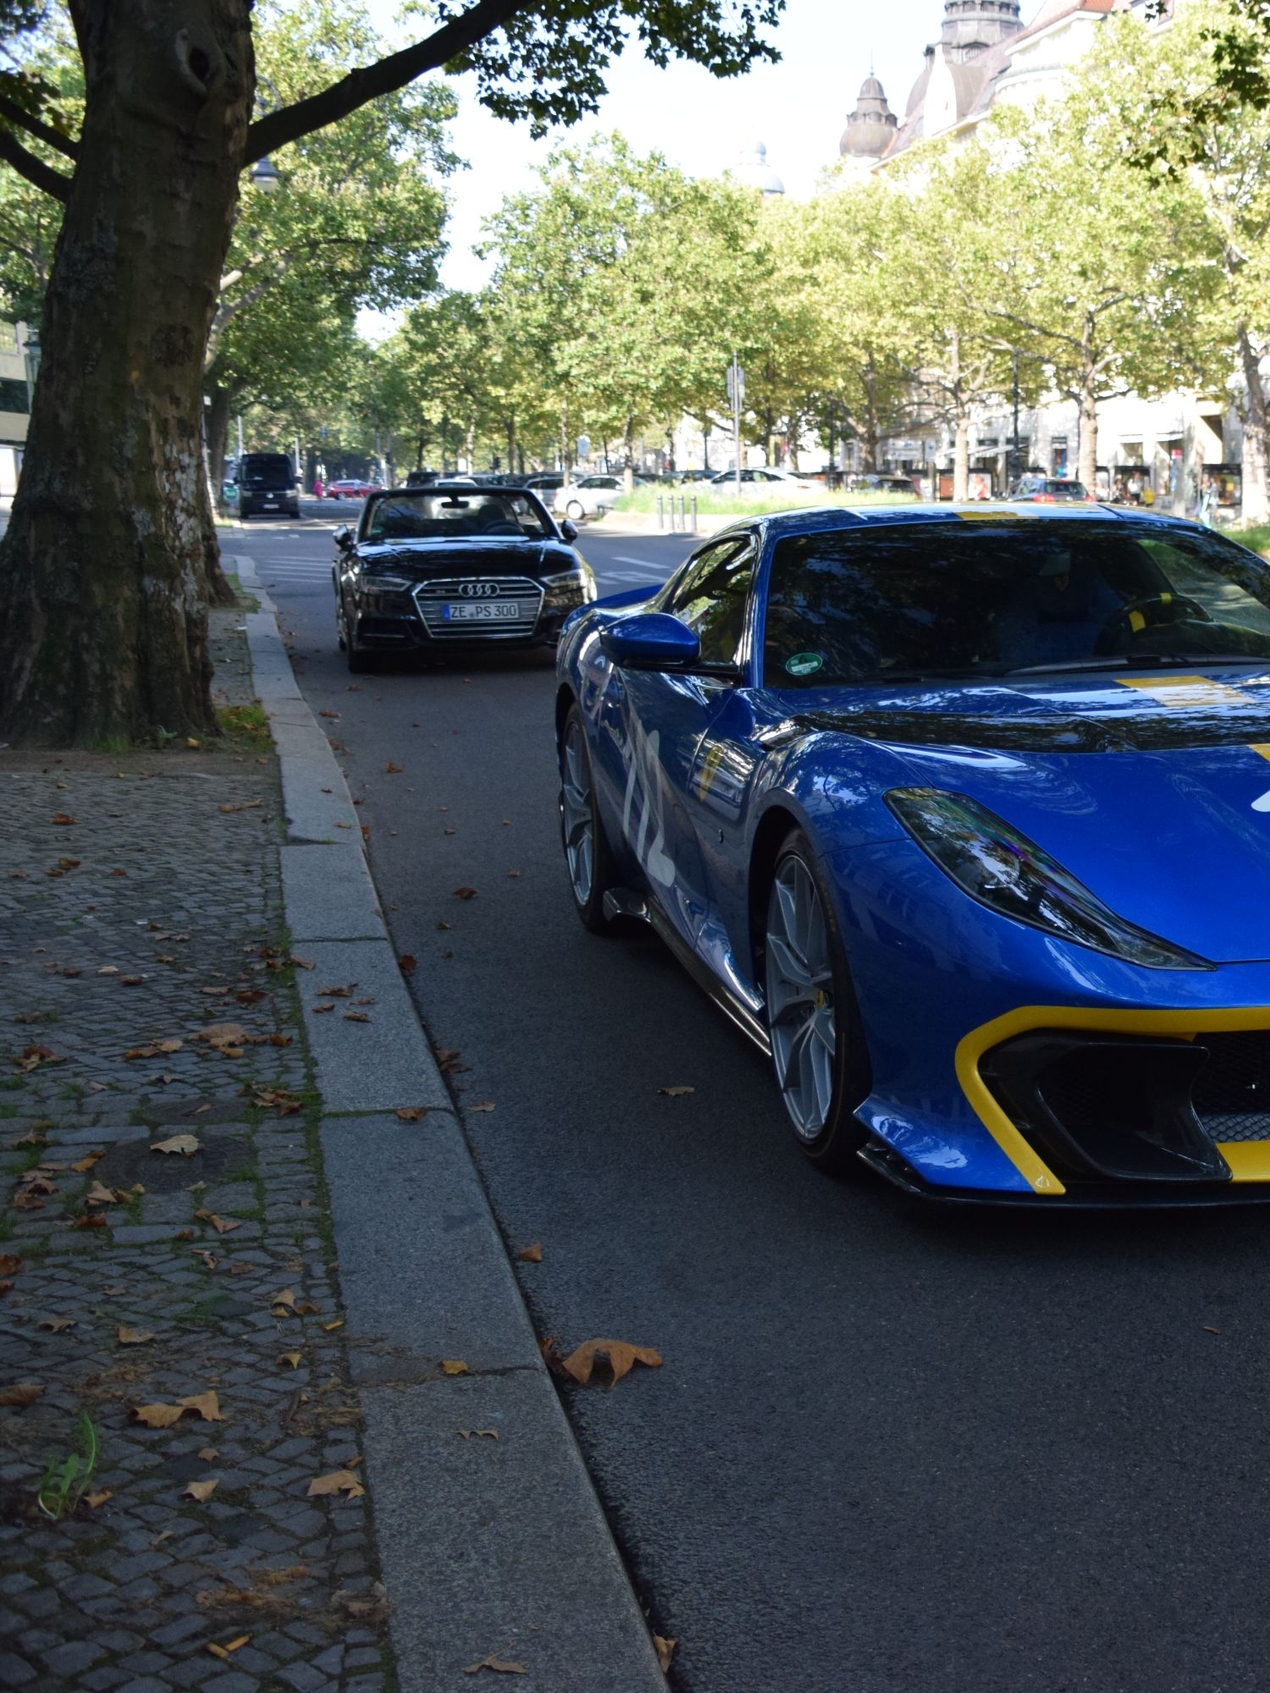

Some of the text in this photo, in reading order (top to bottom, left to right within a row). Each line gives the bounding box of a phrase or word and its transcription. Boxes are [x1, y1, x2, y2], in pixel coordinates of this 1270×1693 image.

[450, 604, 517, 618] ZE PS 300
